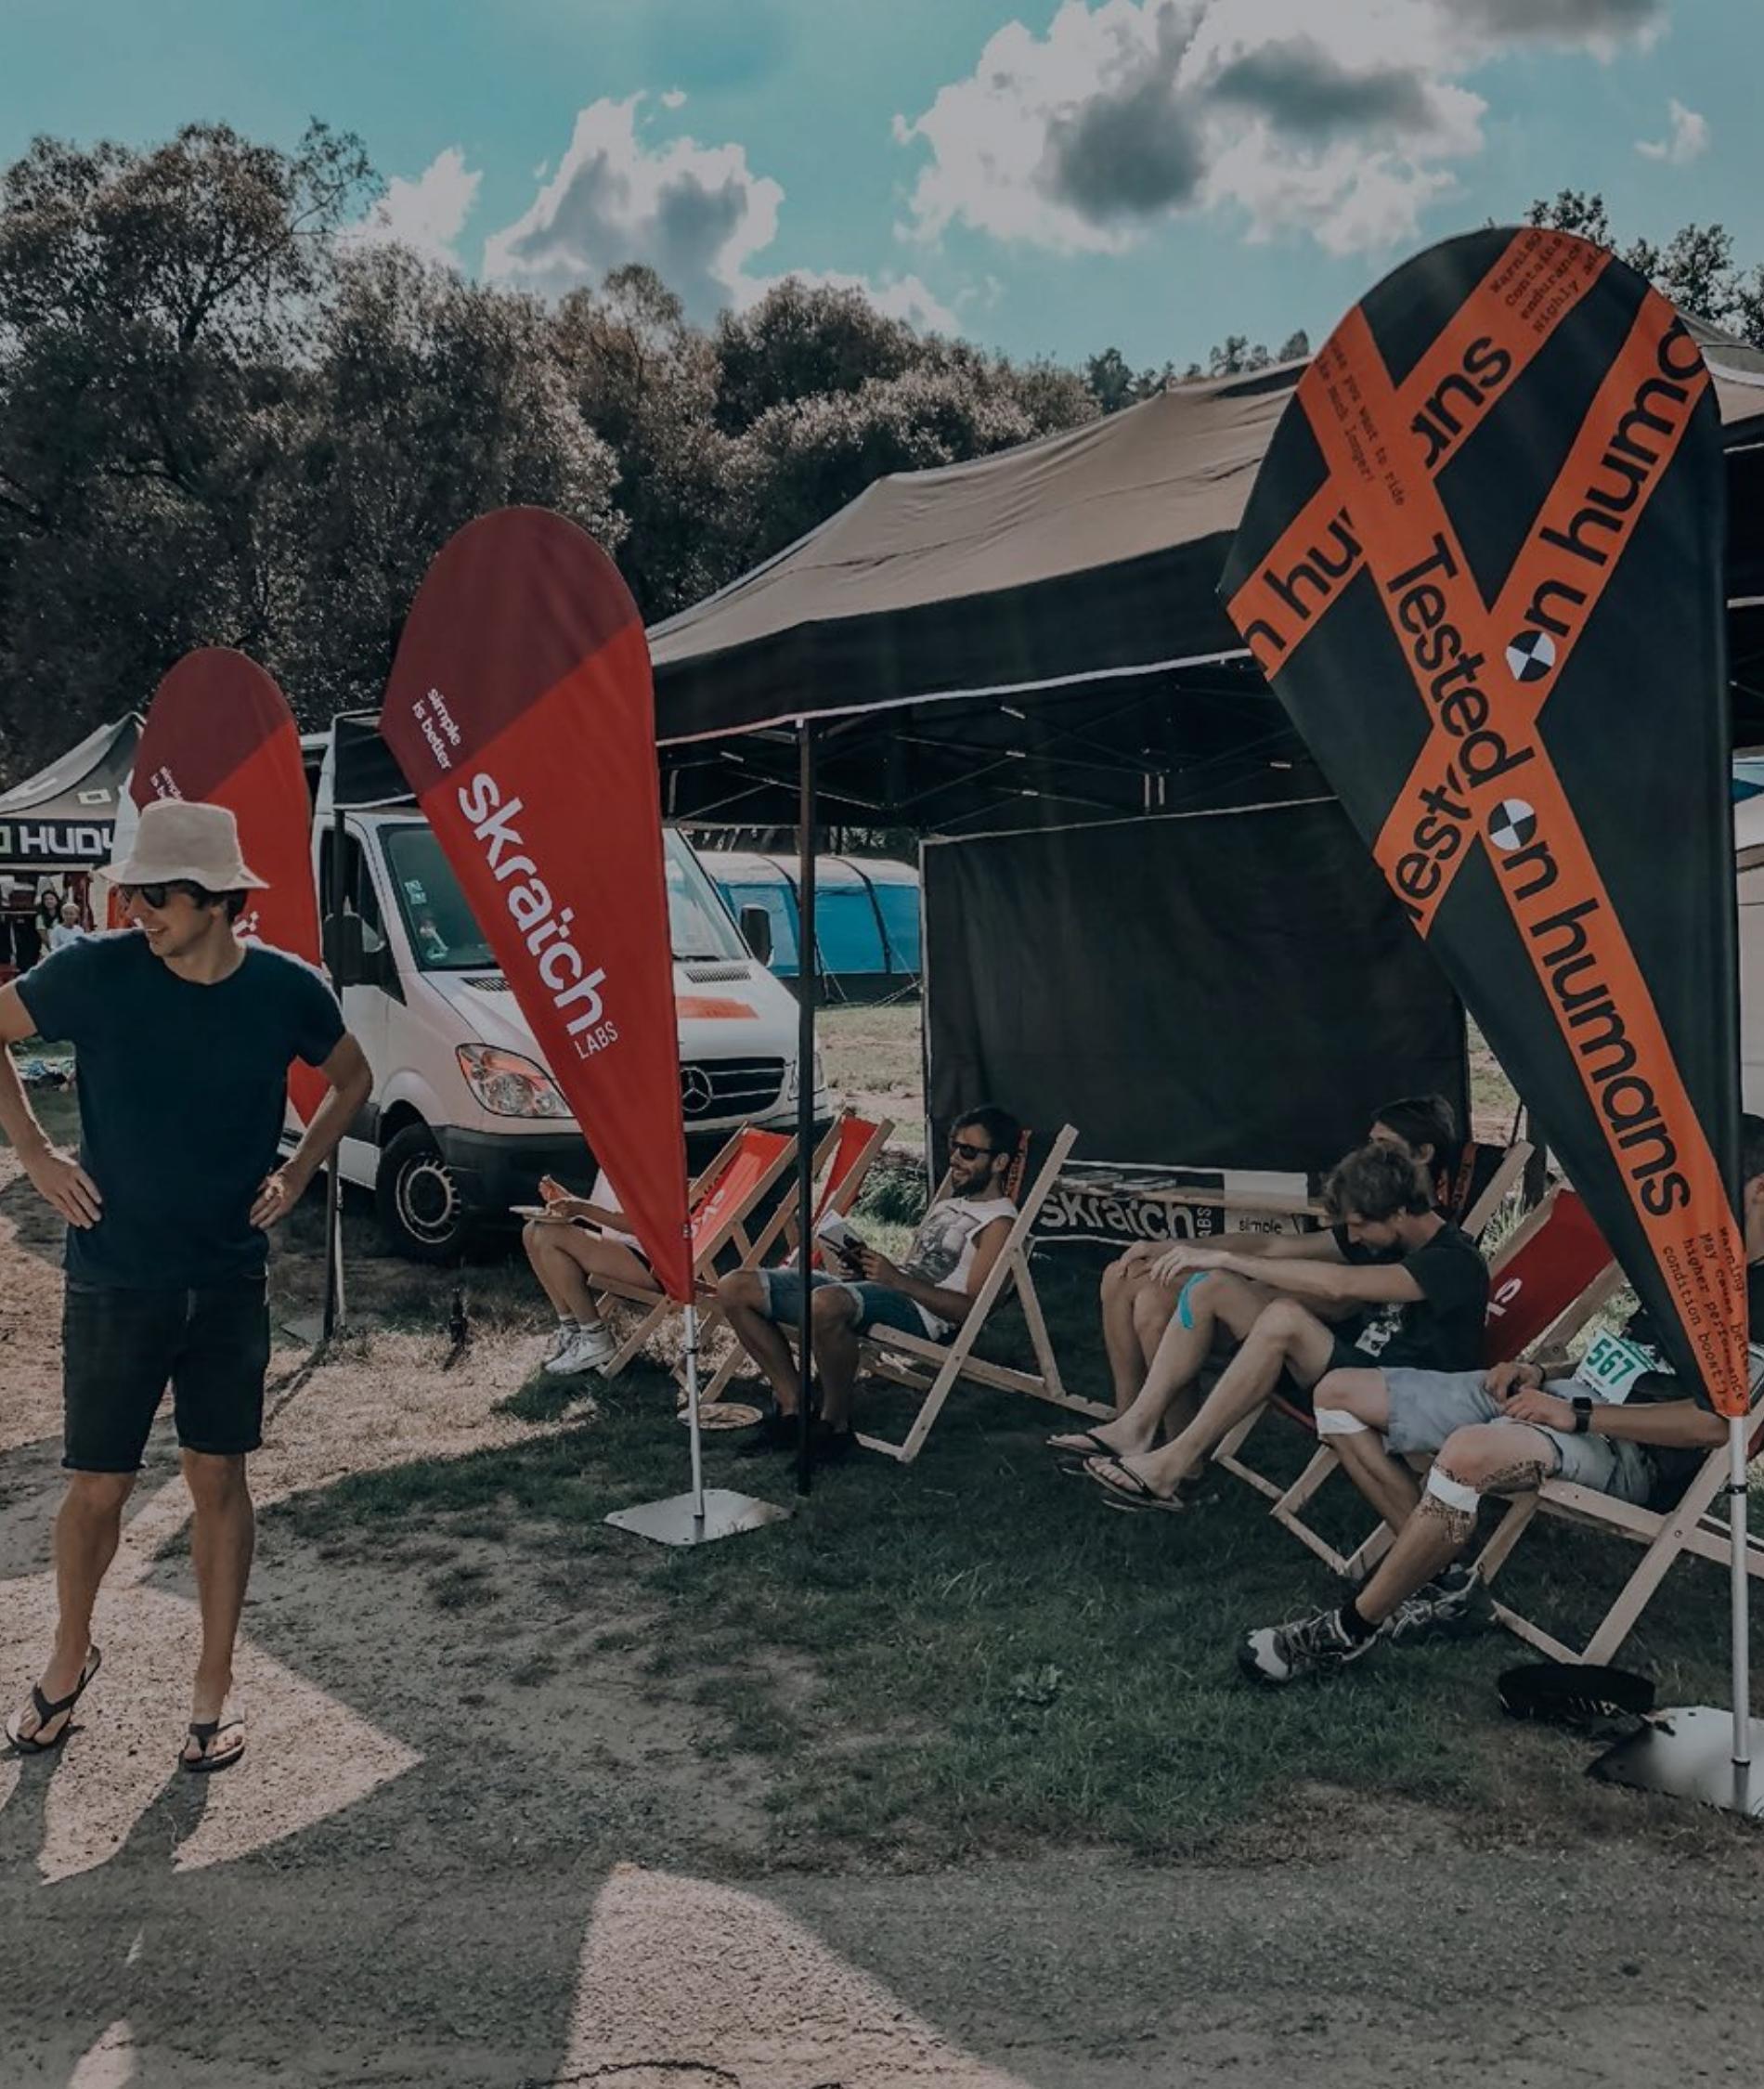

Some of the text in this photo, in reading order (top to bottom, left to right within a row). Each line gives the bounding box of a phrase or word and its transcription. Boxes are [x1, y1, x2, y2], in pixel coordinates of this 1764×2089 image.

[411, 698, 452, 770] is better
[427, 688, 461, 746] simple
[1387, 532, 1537, 789] Tested
[1529, 897, 1692, 1216] humans
[458, 772, 607, 1036] skratch
[574, 1021, 619, 1059] LABS
[1039, 1191, 1197, 1241] skratch
[1662, 1245, 1701, 1326] condition
[1681, 1237, 1710, 1293] higher
[1586, 1337, 1637, 1385] 567
